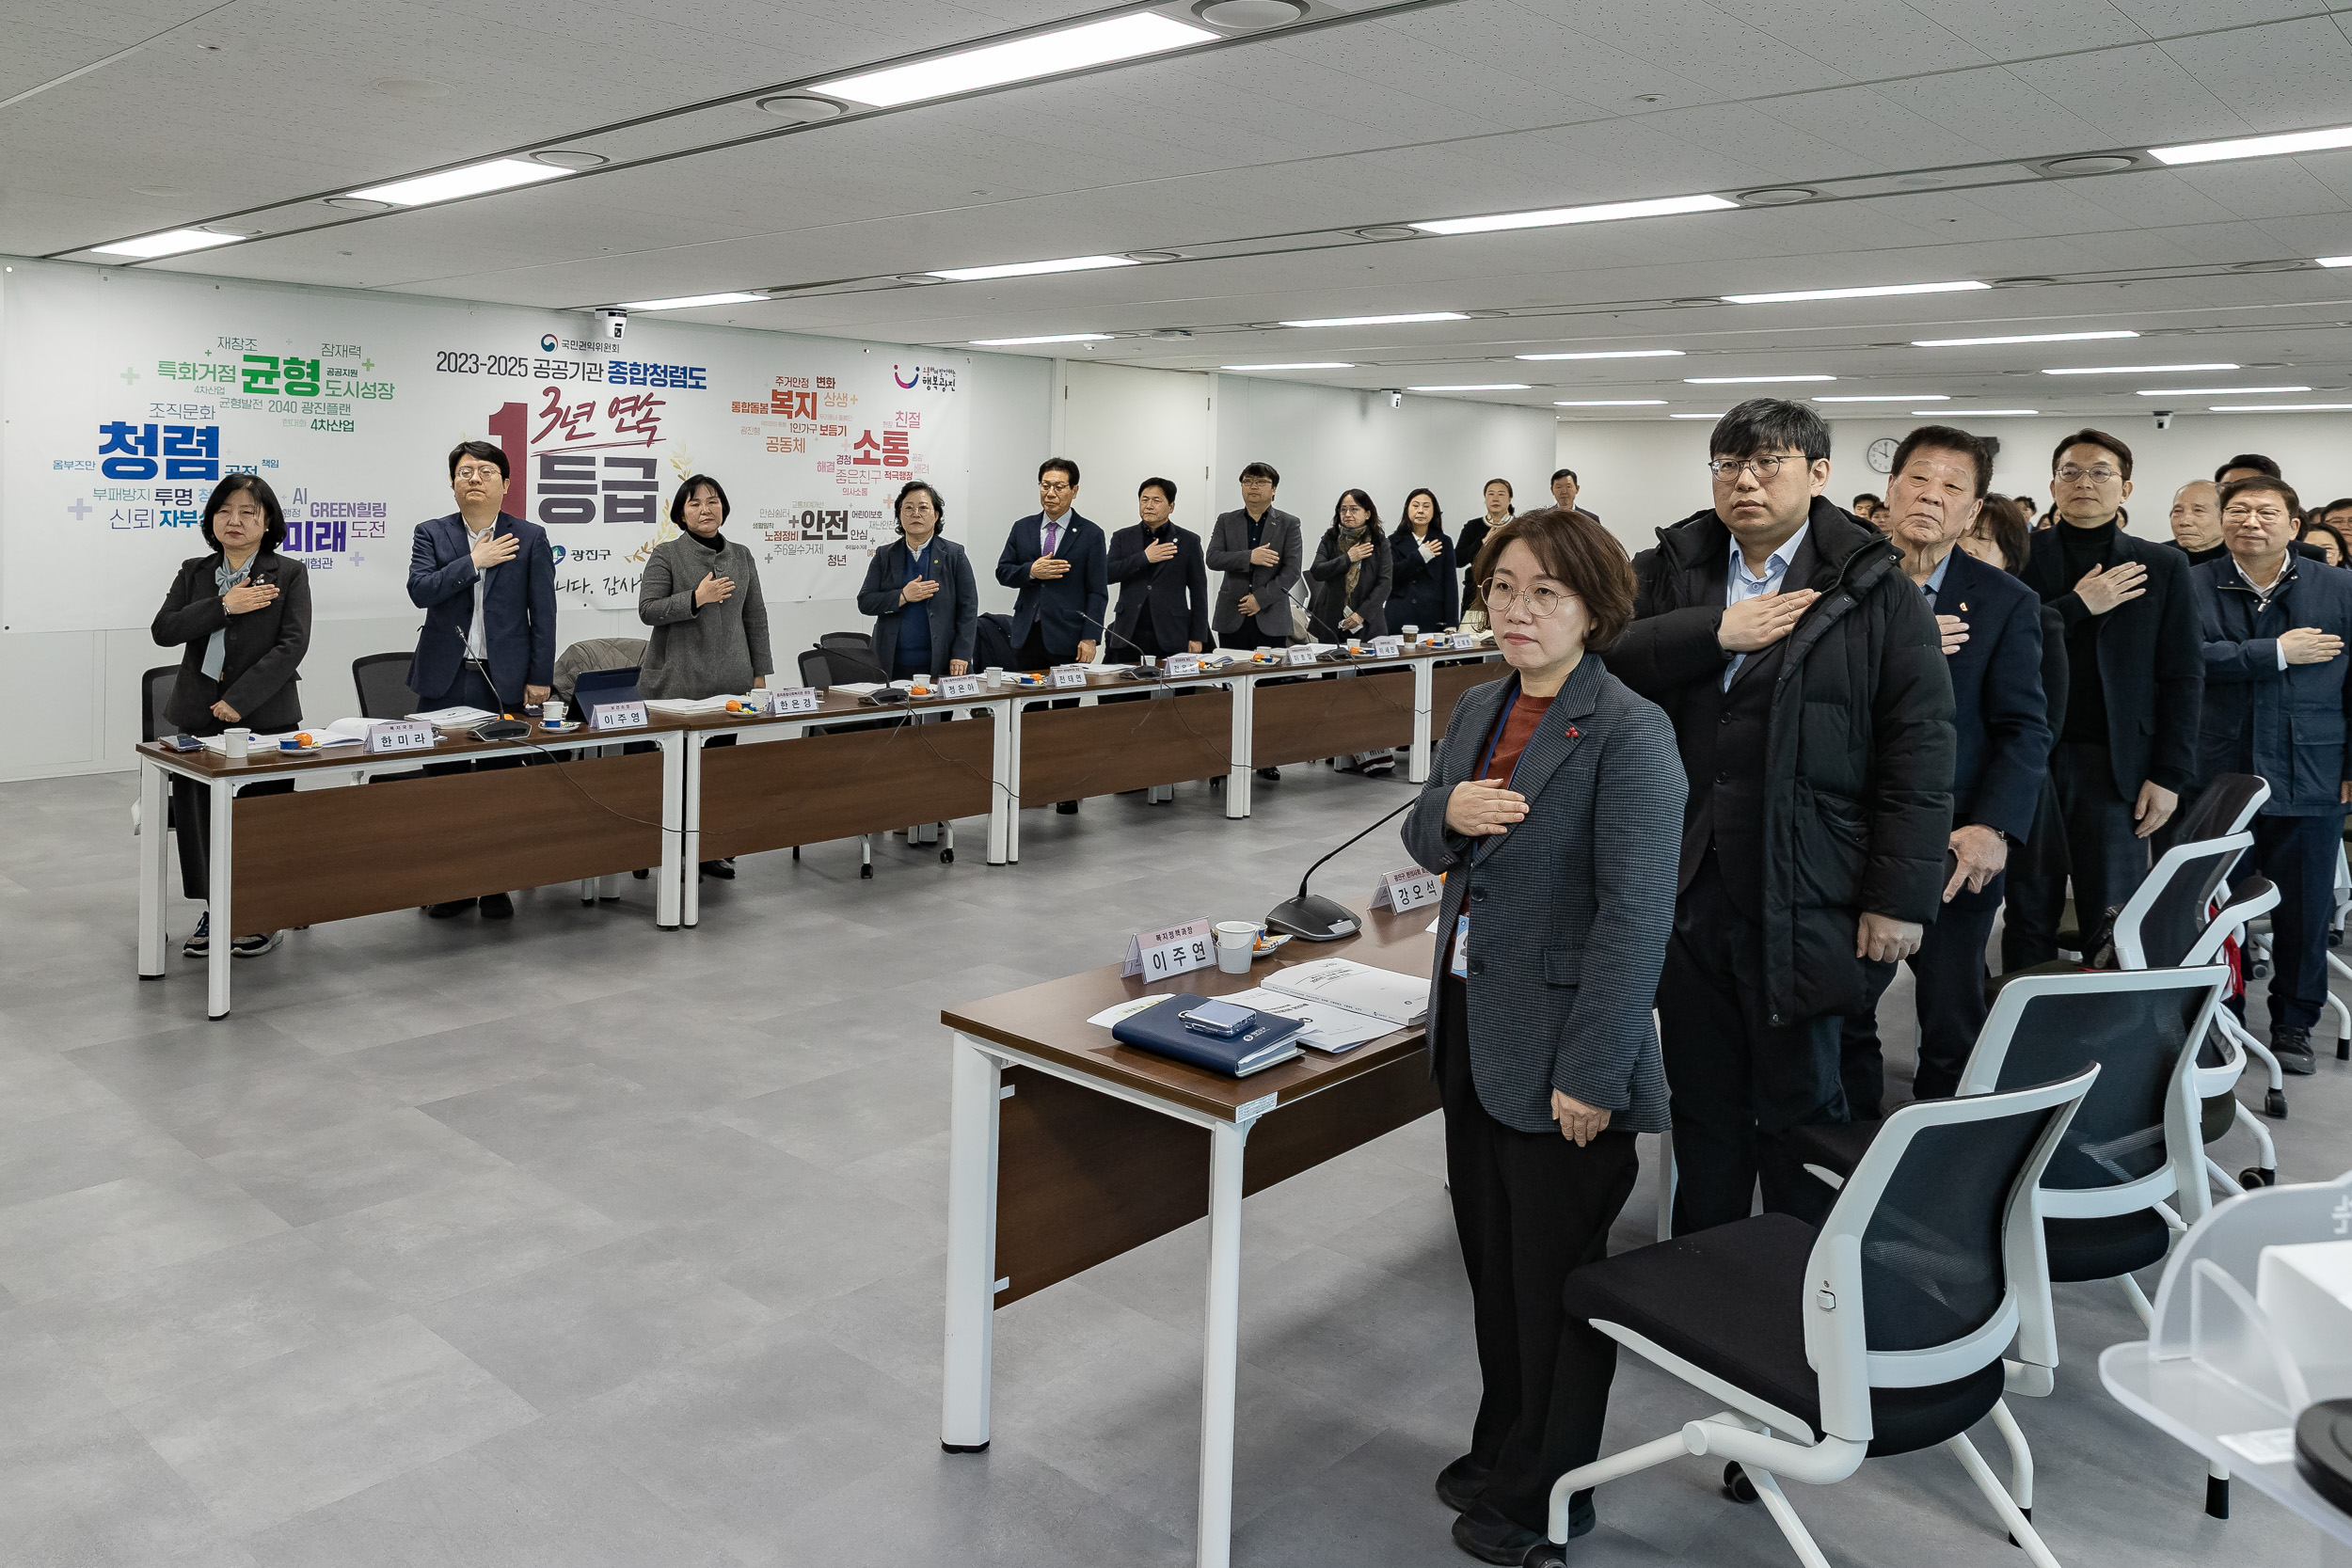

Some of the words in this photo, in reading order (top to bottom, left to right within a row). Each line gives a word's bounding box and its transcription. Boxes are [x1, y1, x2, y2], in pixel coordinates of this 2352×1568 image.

[217, 336, 258, 352] 재창조
[321, 342, 361, 358] 잠재력
[562, 339, 620, 354] 국민권익위원회
[157, 360, 236, 383] 특화거점
[242, 355, 321, 397] 균형
[326, 368, 358, 377] 공공지원
[436, 350, 528, 377] 2023-2025
[533, 358, 604, 382] 공공기관
[608, 360, 707, 389] 종합청렴도
[775, 375, 809, 388] 주거안정
[816, 376, 836, 389] 변화
[922, 375, 956, 392] 행복광진
[194, 386, 225, 396] 4차산업
[325, 380, 395, 401] 도시성장
[219, 397, 263, 410] 균형발전
[268, 400, 297, 414] 2040
[301, 401, 351, 416] 광진플랜
[771, 389, 818, 420] 복지
[824, 392, 848, 408] 상생
[149, 403, 215, 420] 조직문화
[531, 386, 596, 444] 3년
[608, 392, 667, 448] 연속
[895, 410, 921, 429] 친절
[310, 419, 355, 433] 4차산업
[790, 422, 818, 434] 1인가구
[819, 424, 848, 436] 보듬기
[99, 420, 219, 481] 청렴
[766, 436, 805, 453] 공동체
[852, 430, 910, 467] 소통
[53, 460, 96, 471] 옴부즈만
[262, 459, 279, 468] 책임
[488, 402, 528, 519] 1
[537, 454, 660, 524] 등급
[817, 461, 835, 473] 해결
[836, 454, 851, 466] 경청
[835, 468, 882, 484] 좋은친구
[884, 470, 914, 481] 적극행정
[92, 488, 151, 501] 부패방지
[154, 488, 193, 506] 투명
[293, 487, 308, 505] AI
[842, 487, 868, 497] 의사소통
[310, 501, 387, 518] GREEN힐링
[760, 509, 790, 518] 안심쉼터
[851, 510, 882, 519] 어린이보호
[109, 509, 154, 530] 신뢰
[801, 510, 849, 541] 안전
[282, 521, 346, 552] 미래
[351, 521, 386, 538] 도전
[765, 531, 799, 542] 노점정비
[850, 530, 868, 541] 안심
[570, 549, 612, 562] 광진구
[773, 544, 824, 556] 주6일수거제
[827, 554, 847, 566] 청년
[555, 578, 594, 594] 니다.
[603, 573, 643, 595] 감사
[780, 698, 811, 710] 한은경
[604, 712, 640, 725] 이주영
[381, 733, 425, 748] 한미라
[1398, 879, 1438, 905] 강오석
[1155, 926, 1193, 942] 복지정책과장
[1152, 941, 1205, 972] 이주연
